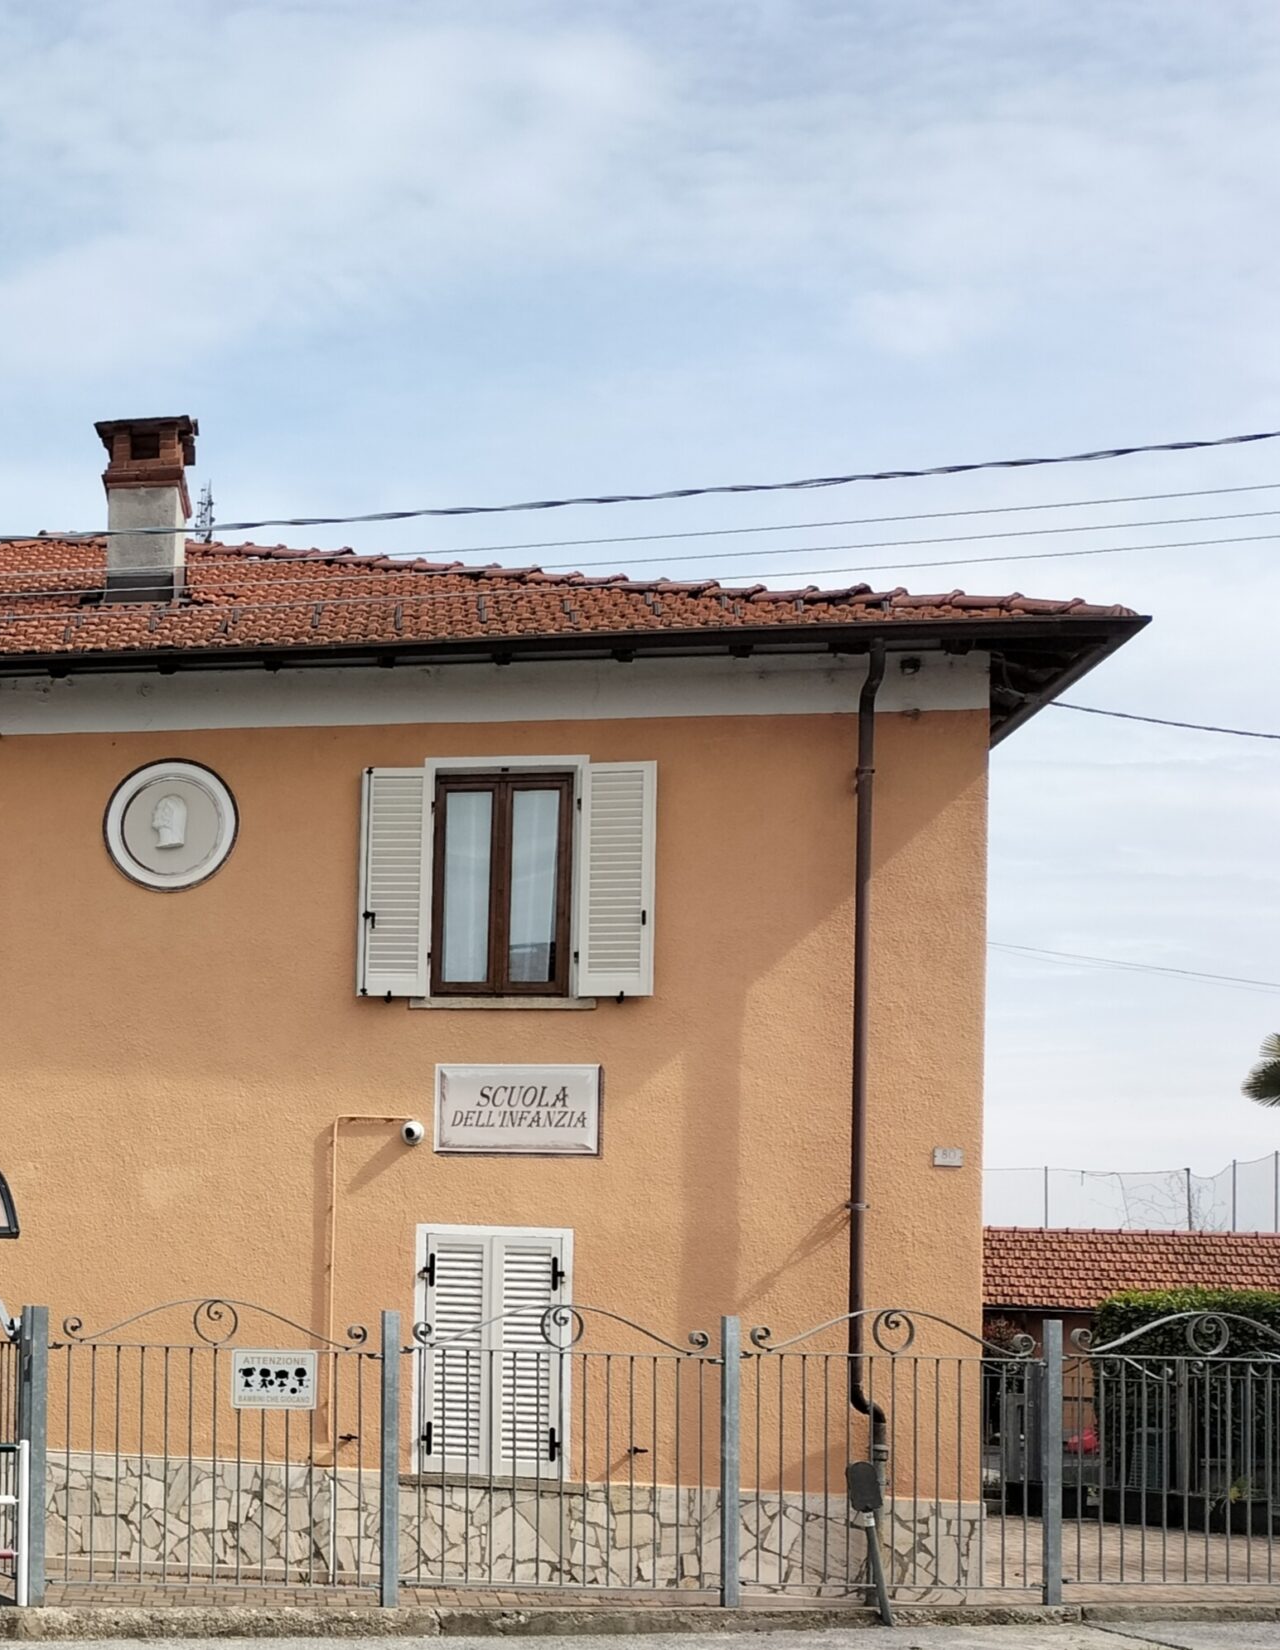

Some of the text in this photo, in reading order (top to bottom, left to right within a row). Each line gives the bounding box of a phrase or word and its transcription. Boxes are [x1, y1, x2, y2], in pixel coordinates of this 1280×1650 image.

[476, 1086, 569, 1108] SCUOLA
[451, 1110, 587, 1128] DELL'INFANZIA
[243, 1356, 307, 1366] ATTENZIONE
